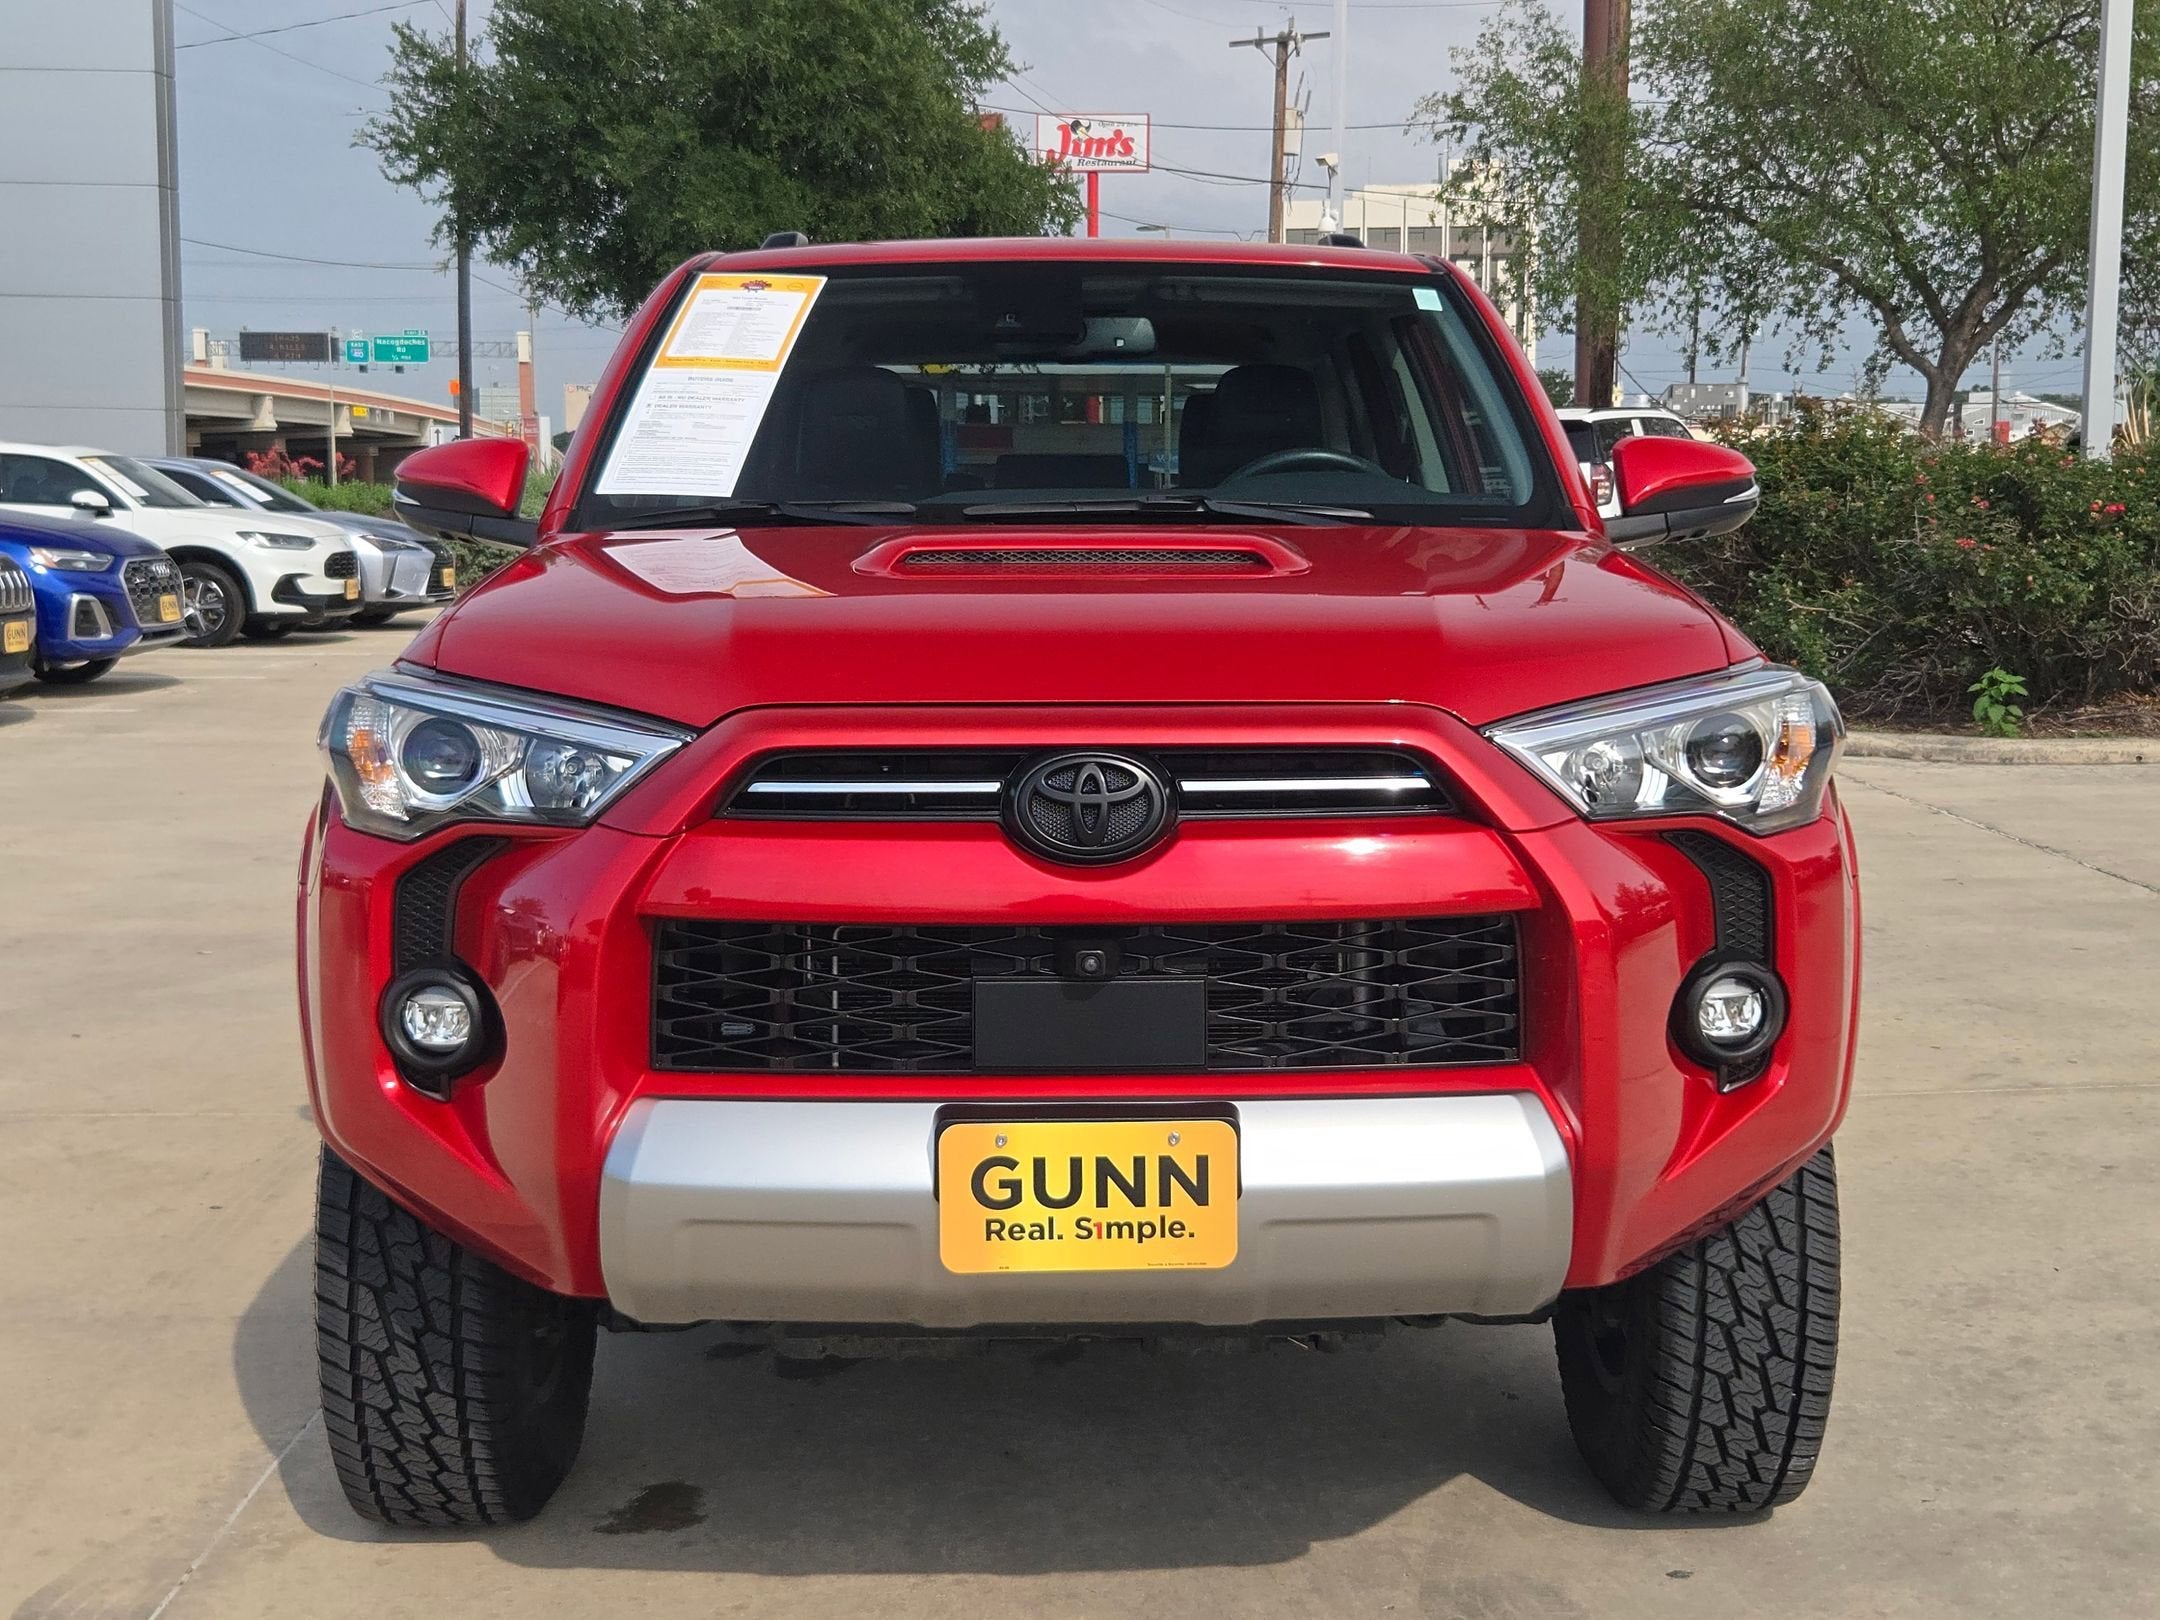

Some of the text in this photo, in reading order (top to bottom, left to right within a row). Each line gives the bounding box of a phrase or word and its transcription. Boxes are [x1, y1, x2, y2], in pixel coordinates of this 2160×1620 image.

[1046, 123, 1135, 163] Jim's
[1077, 158, 1137, 167] Restaurant
[376, 338, 426, 346] Nacogdoches
[7, 627, 26, 640] GUNN
[970, 1154, 1209, 1210] GUNN
[985, 1214, 1195, 1244] Real. S1mple.
